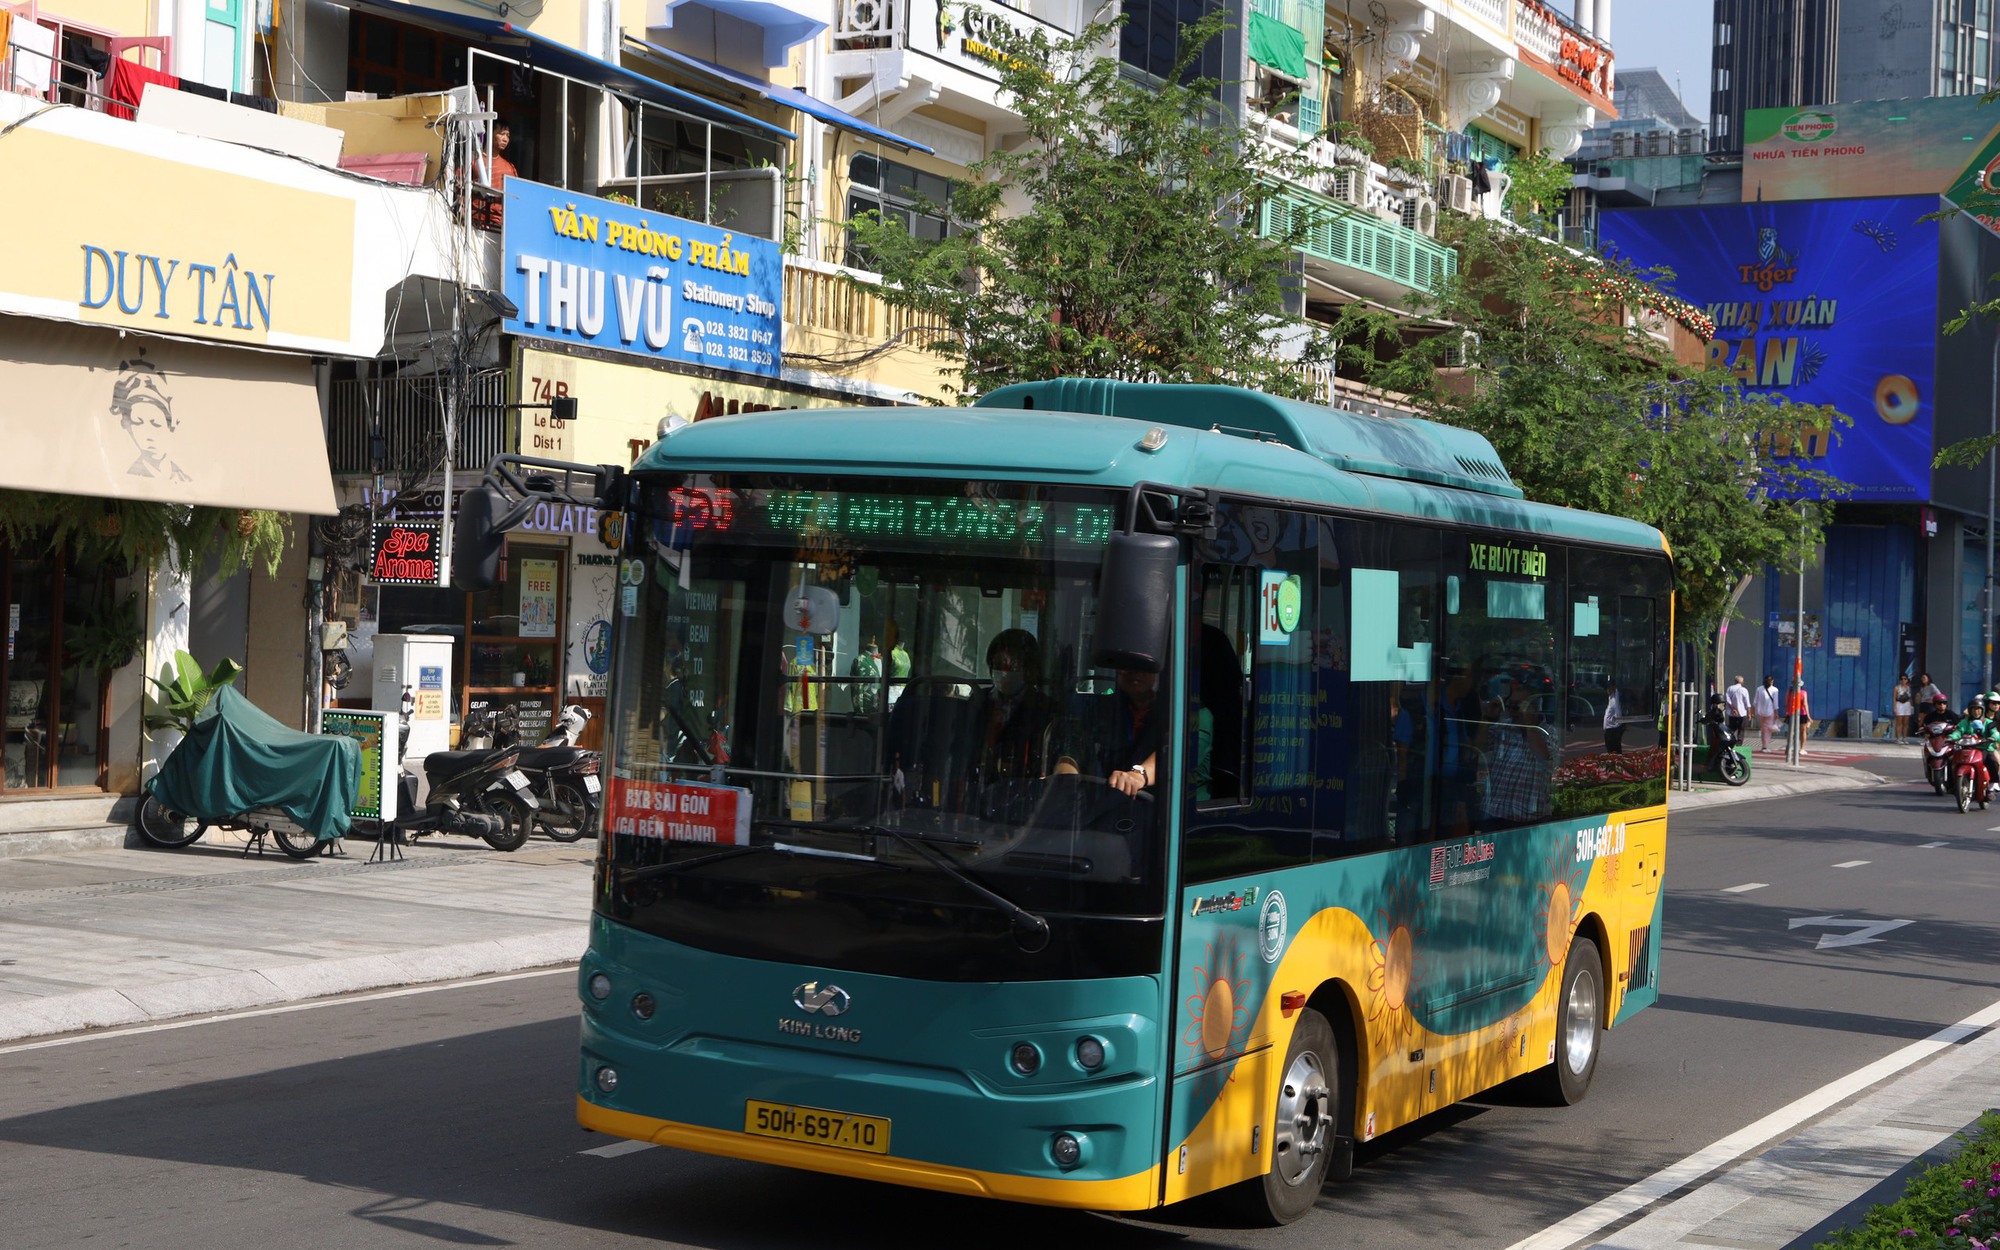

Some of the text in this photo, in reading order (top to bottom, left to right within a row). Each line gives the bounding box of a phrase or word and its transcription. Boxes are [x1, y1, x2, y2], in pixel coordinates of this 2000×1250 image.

[1823, 145, 1865, 156] PHONG
[549, 202, 750, 277] VĂN PHÒNG PHẨM
[79, 244, 276, 332] DUY TÂN
[1738, 262, 1798, 292] Tiger
[516, 254, 672, 351] THU VŨ
[682, 279, 776, 320] Stationery Shop
[1706, 293, 1837, 326] KHAI XUÂN
[706, 320, 773, 346] 028. 3821 0647
[706, 346, 772, 366] 028. 3821 8528
[534, 413, 546, 427] Le
[533, 434, 562, 451] Dist 1
[848, 498, 904, 535] NHI
[383, 526, 429, 557] Spa
[374, 550, 435, 580] Aroma
[1469, 540, 1547, 582] XE BUÝT ĐIỆN
[528, 580, 550, 592] FREE
[685, 592, 717, 611] VIETNAM
[1263, 582, 1279, 631] 15
[689, 624, 710, 643] BEAN
[588, 673, 607, 682] CACAO
[693, 657, 703, 675] TO
[689, 690, 704, 707] BAR
[518, 720, 547, 728] CHEESECAKE
[538, 710, 552, 718] CAKES
[654, 788, 676, 812] SÀI
[680, 790, 710, 816] GÒN
[1575, 822, 1625, 863] 50H-697.10
[778, 1017, 861, 1043] KIM LONG
[757, 1107, 876, 1146] 50H-697.10
